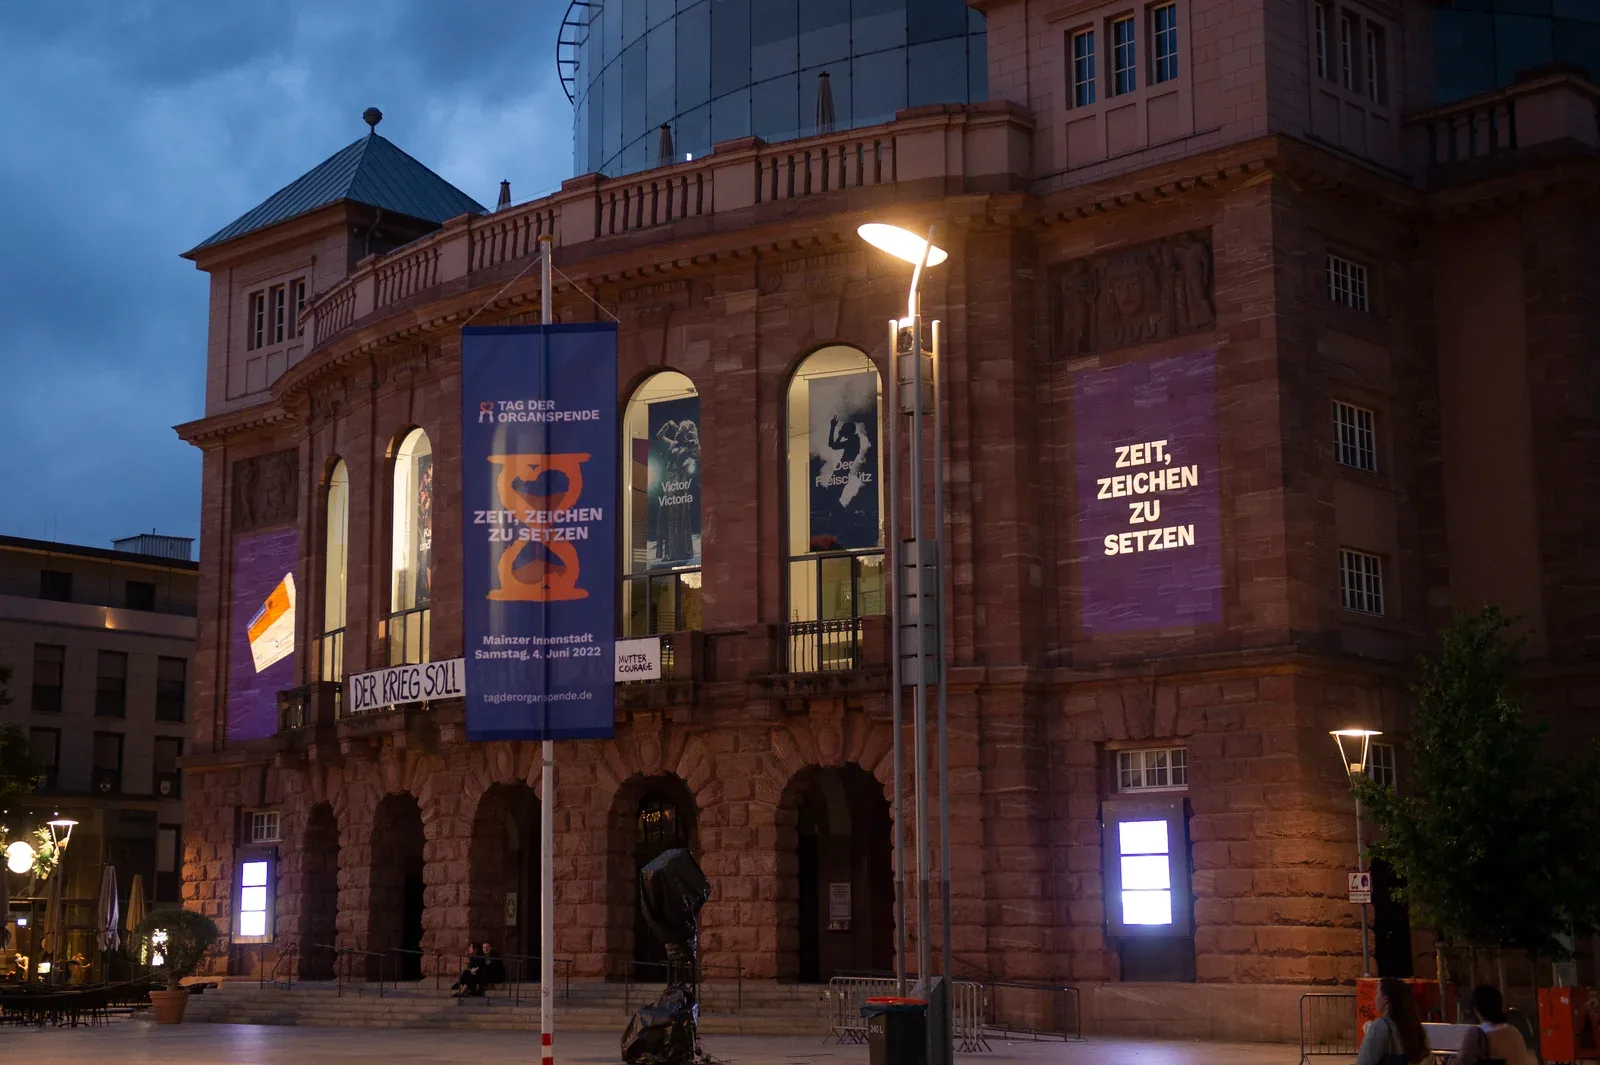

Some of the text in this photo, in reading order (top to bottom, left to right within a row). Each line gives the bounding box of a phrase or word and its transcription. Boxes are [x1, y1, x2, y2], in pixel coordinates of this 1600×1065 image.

[497, 399, 555, 411] TAG DER
[497, 409, 600, 423] ORGANSPENDE
[1115, 439, 1171, 469] ZEIT,
[661, 478, 692, 493] Victor/
[1097, 464, 1198, 500] ZEICHEN
[658, 492, 693, 507] Victoria
[473, 507, 603, 526] ZEIT, ZEICHEN
[1129, 499, 1160, 525] ZU
[487, 526, 589, 542] ZU SETZEN
[1104, 524, 1195, 556] SETZEN
[483, 632, 594, 646] Mainzer Innenstadt
[474, 646, 602, 661] Samstag, 4. Juni 2022
[618, 653, 647, 665] MUTTER
[618, 661, 653, 673] COURAGE
[354, 661, 461, 710] DER KRIEG SOLL
[483, 690, 593, 705] tagderorganspende.de
